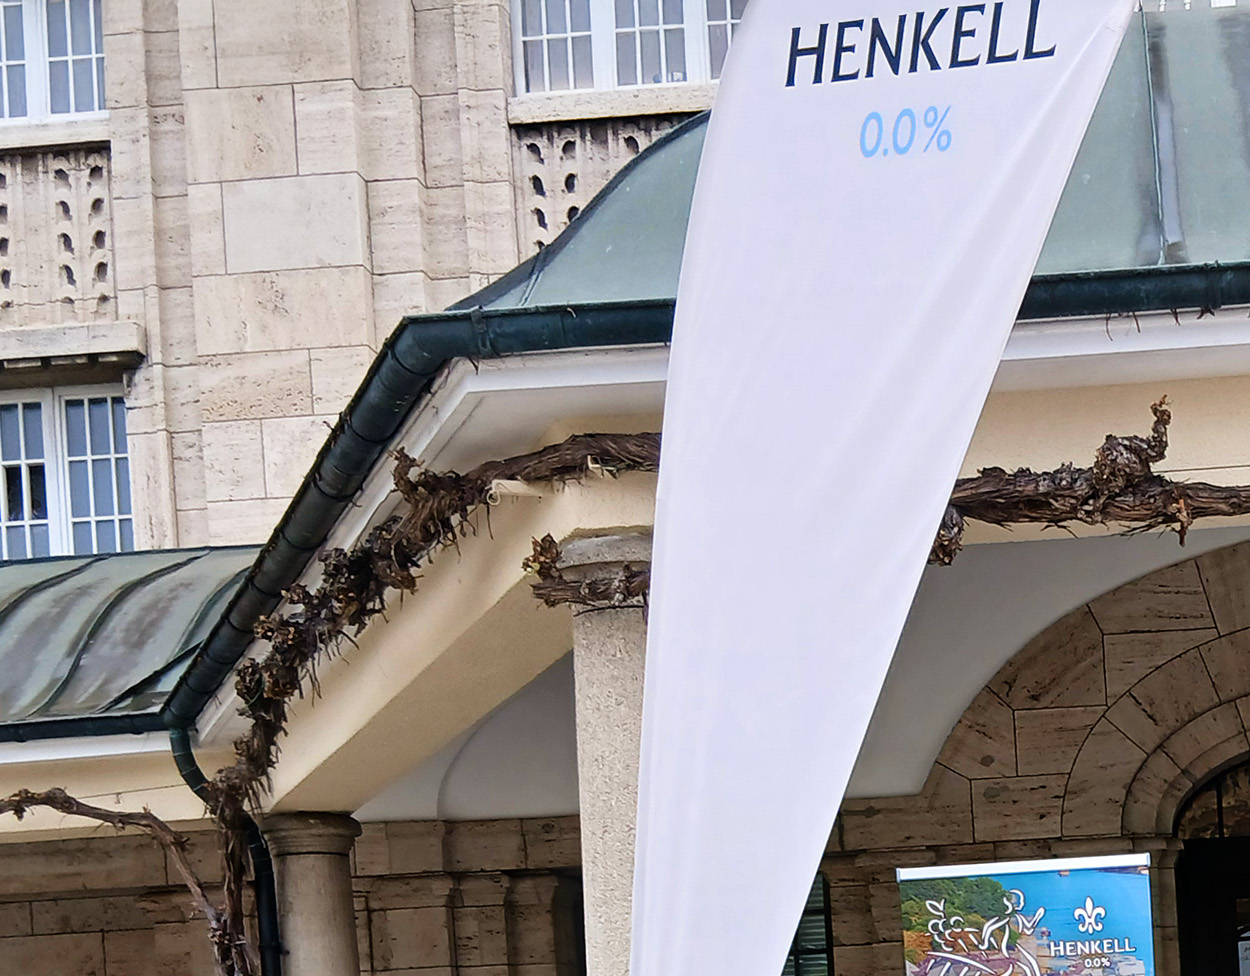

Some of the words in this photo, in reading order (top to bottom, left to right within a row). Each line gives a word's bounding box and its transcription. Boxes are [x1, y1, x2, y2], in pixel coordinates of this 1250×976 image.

[785, 0, 1057, 87] HENKELL
[859, 104, 953, 158] 0.0%
[1049, 938, 1136, 957] HENKELL
[1084, 957, 1111, 968] 0.0%
